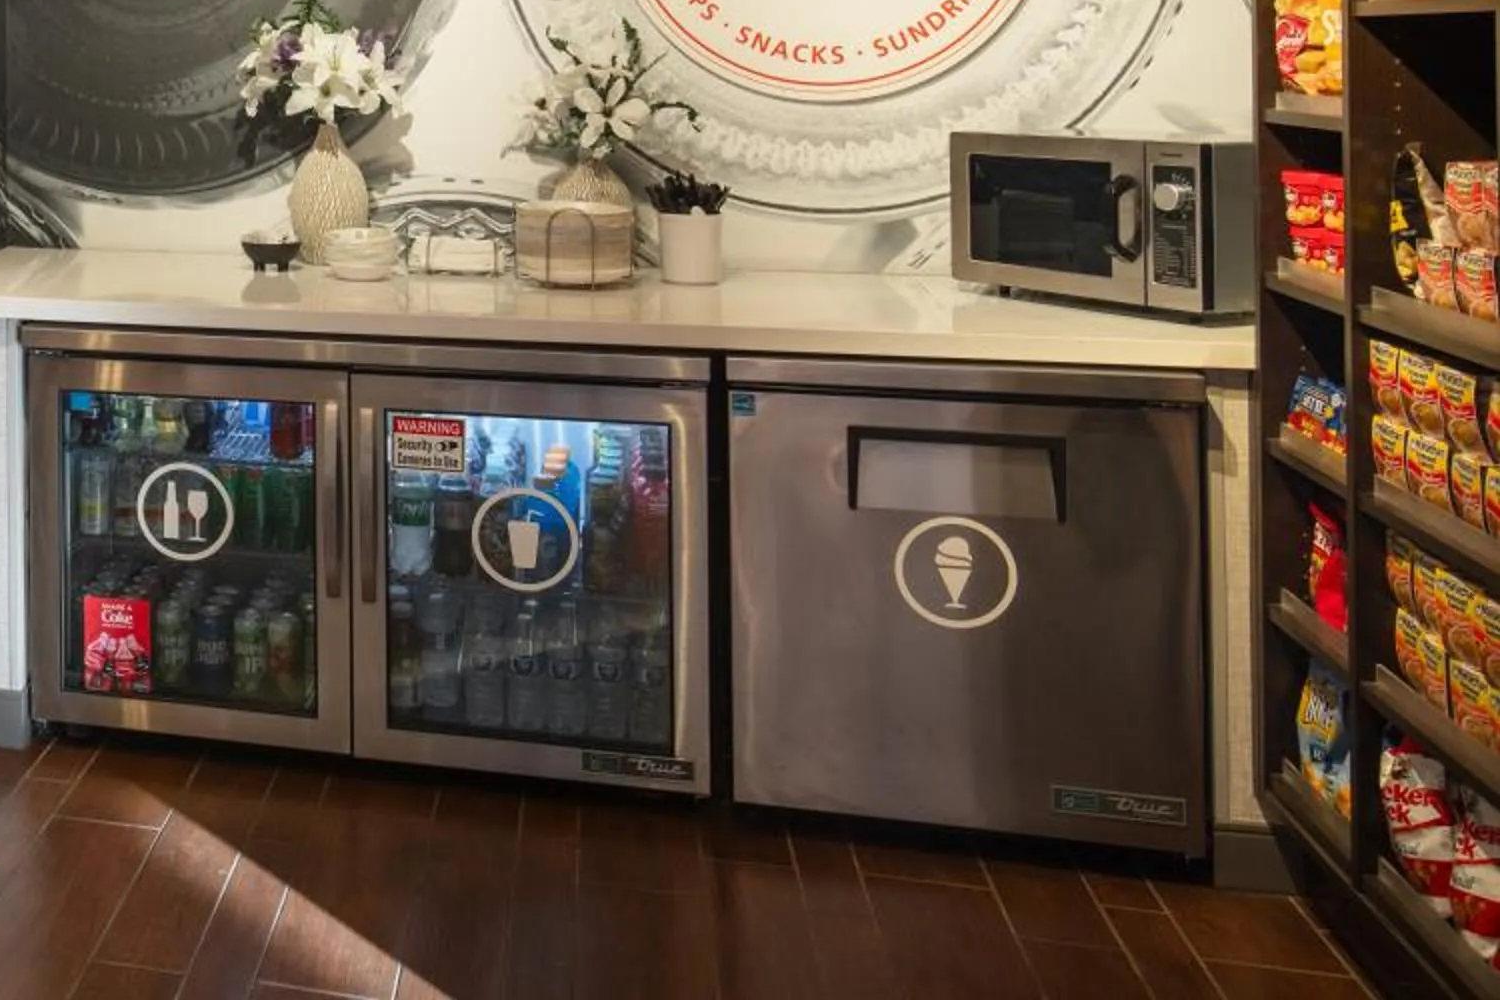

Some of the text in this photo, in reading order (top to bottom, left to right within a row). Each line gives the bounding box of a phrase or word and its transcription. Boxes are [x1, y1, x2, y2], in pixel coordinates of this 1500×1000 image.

[735, 25, 845, 64] SNACKS
[396, 419, 460, 435] WARNING
[397, 437, 433, 454] Security
[101, 610, 134, 626] Coke
[1381, 783, 1440, 807] cker
